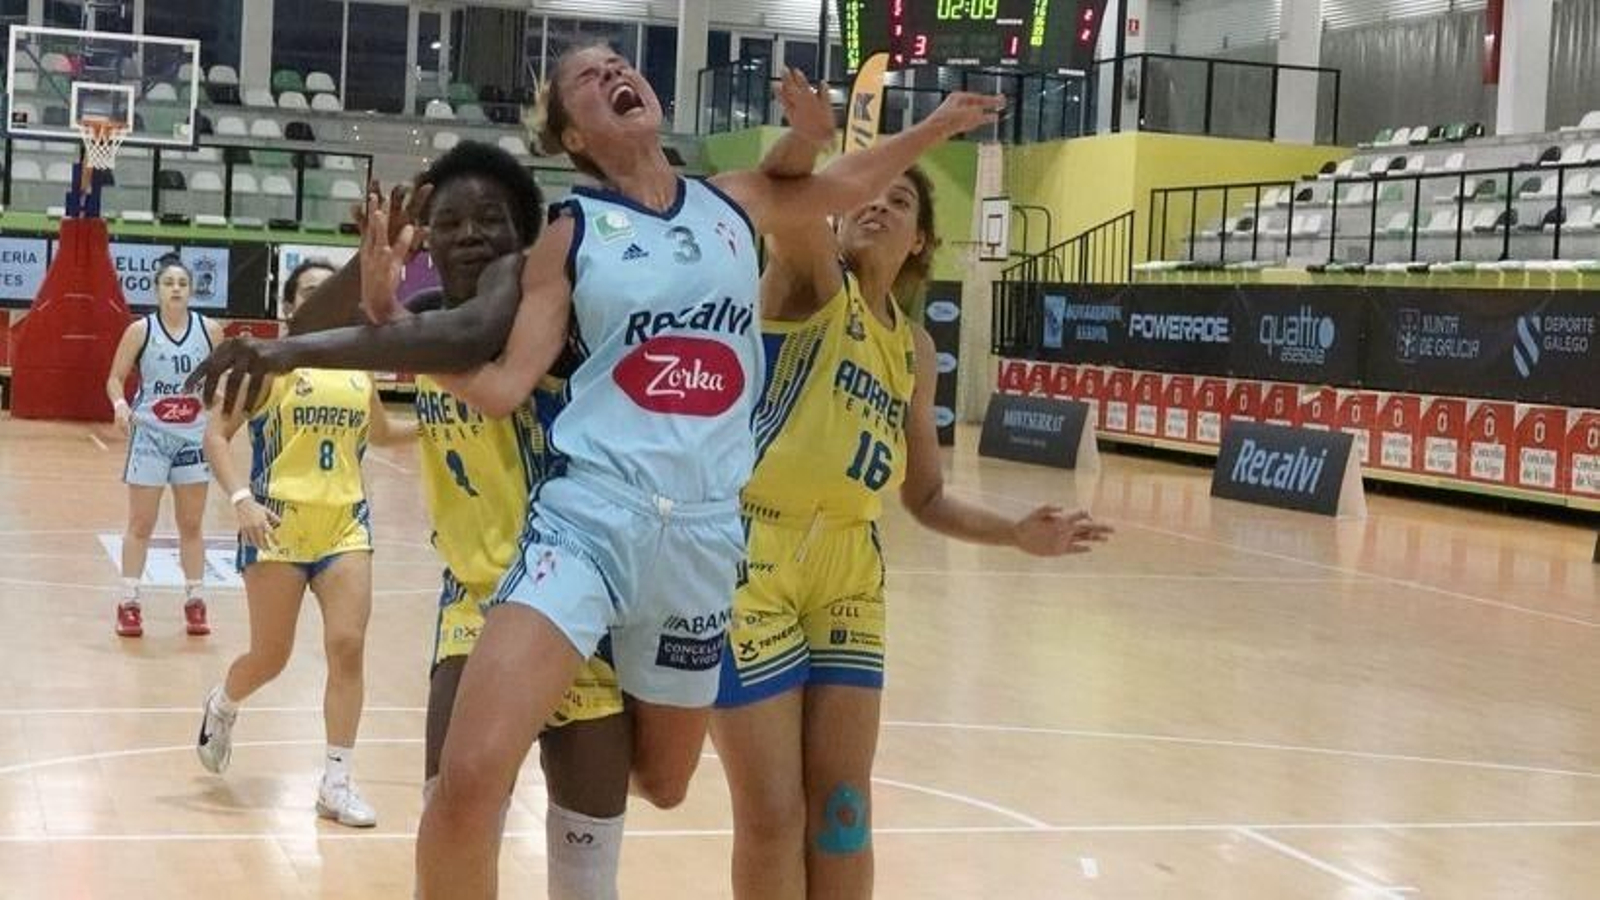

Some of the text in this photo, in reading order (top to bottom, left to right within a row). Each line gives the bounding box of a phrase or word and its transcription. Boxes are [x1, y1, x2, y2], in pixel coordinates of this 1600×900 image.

[914, 35, 927, 55] 3
[667, 226, 702, 264] 3
[0, 273, 23, 287] ES
[1128, 313, 1230, 343] POWERADE
[1260, 304, 1335, 357] quattro
[1422, 315, 1459, 334] XUNTA
[1544, 316, 1595, 333] DEPORTE
[1420, 336, 1480, 359] DE GALICIA
[1543, 336, 1588, 354] GALEGO
[171, 354, 192, 374] 10
[644, 350, 725, 398] Zorka
[319, 438, 335, 471] 8
[846, 430, 892, 492] 16
[1232, 438, 1328, 495] Recalvi
